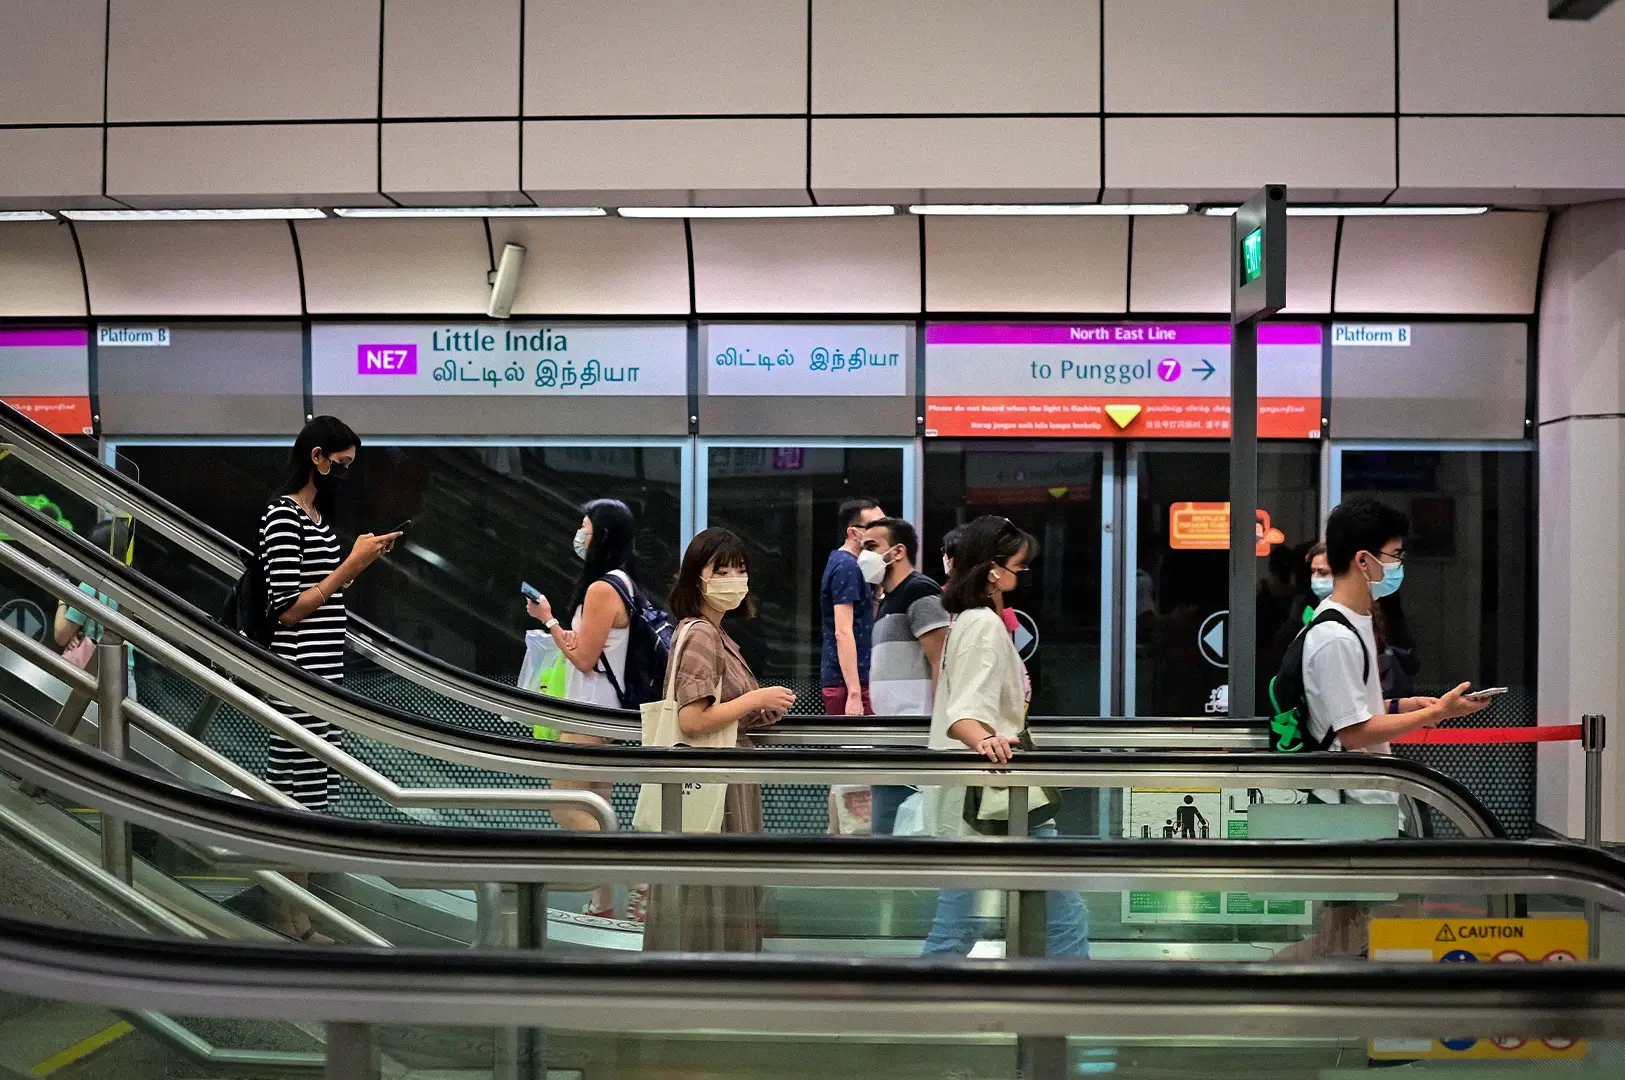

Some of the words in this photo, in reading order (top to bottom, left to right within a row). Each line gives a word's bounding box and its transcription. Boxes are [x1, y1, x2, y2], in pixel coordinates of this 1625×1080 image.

[100, 327, 153, 342] Platform
[158, 328, 166, 342] B
[432, 328, 495, 352] Little
[504, 328, 567, 352] India
[1069, 327, 1109, 340] North
[1115, 327, 1144, 340] East
[1148, 327, 1177, 340] Line
[1336, 326, 1393, 342] Platform
[1398, 327, 1407, 342] B
[367, 350, 408, 370] NE7
[715, 347, 795, 371] லிட்டில்
[809, 347, 900, 373] இந்தியா
[432, 359, 525, 388] லிட்டில்
[534, 359, 640, 390] இந்தியா
[1030, 361, 1052, 379] to
[1062, 359, 1151, 384] Punggol
[1162, 361, 1178, 379] 7
[927, 404, 952, 412] Please
[954, 404, 965, 412] do
[966, 404, 980, 412] not
[981, 404, 1005, 412] board
[1029, 404, 1042, 412] the
[1043, 404, 1061, 413] light
[1063, 404, 1070, 412] is
[1071, 404, 1101, 413] flashing
[1457, 925, 1524, 939] CAUTION
